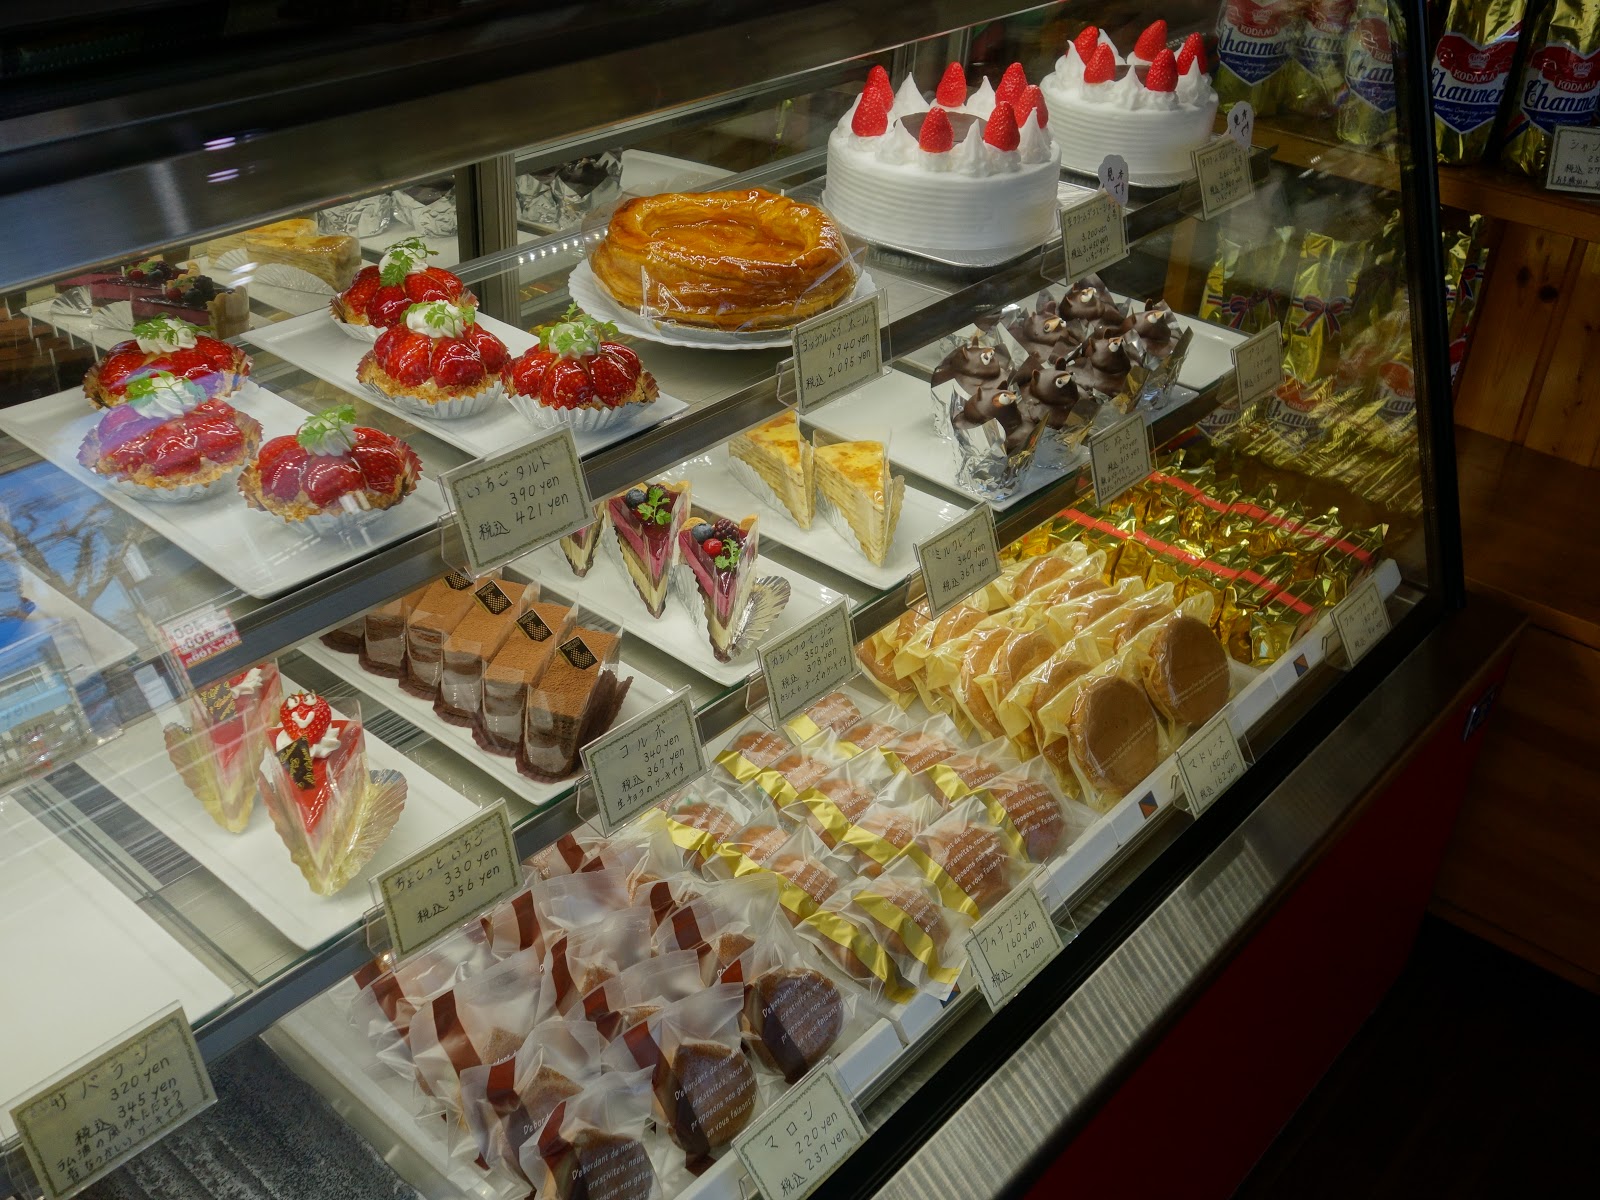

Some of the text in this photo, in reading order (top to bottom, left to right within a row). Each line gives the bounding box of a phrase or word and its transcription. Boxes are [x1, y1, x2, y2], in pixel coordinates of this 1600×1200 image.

[1240, 24, 1279, 36] KODAMA
[1453, 70, 1495, 82] KODAMA
[1557, 79, 1596, 91] KODAMA
[828, 333, 870, 359] 1,940 yen
[828, 357, 854, 379] 2,095
[858, 349, 871, 364] yen
[510, 476, 560, 506] 390 yen
[479, 493, 569, 541] 税込 421 yen
[957, 543, 986, 566] 340 yen
[942, 557, 989, 593] 税込 367 yen
[804, 637, 834, 661] 350 yen
[781, 647, 837, 690] 税込 378 yen
[643, 734, 680, 763] 340 yen
[1221, 749, 1232, 763] yen
[621, 748, 686, 793] 税込 367 yen
[1200, 763, 1238, 800] 税込 162 yen
[444, 846, 498, 885] 330 yen
[417, 864, 501, 924] 税込 356 yen
[1006, 920, 1037, 953] 160 yen
[1013, 947, 1031, 970] 172
[1030, 936, 1044, 954] yen
[793, 979, 801, 990] de
[50, 1042, 149, 1111] サバラン
[109, 1056, 171, 1101] 320 yen
[709, 1066, 718, 1076] de
[728, 1067, 743, 1080] nous
[74, 1076, 177, 1147] 税込 345 yen
[724, 1092, 736, 1104] nos
[706, 1100, 752, 1139] en vous faisant
[764, 1101, 813, 1149] マロン
[795, 1111, 839, 1155] 220 yen
[610, 1146, 619, 1160] de
[628, 1153, 645, 1168] nous
[780, 1127, 849, 1198] 税込 237 yen
